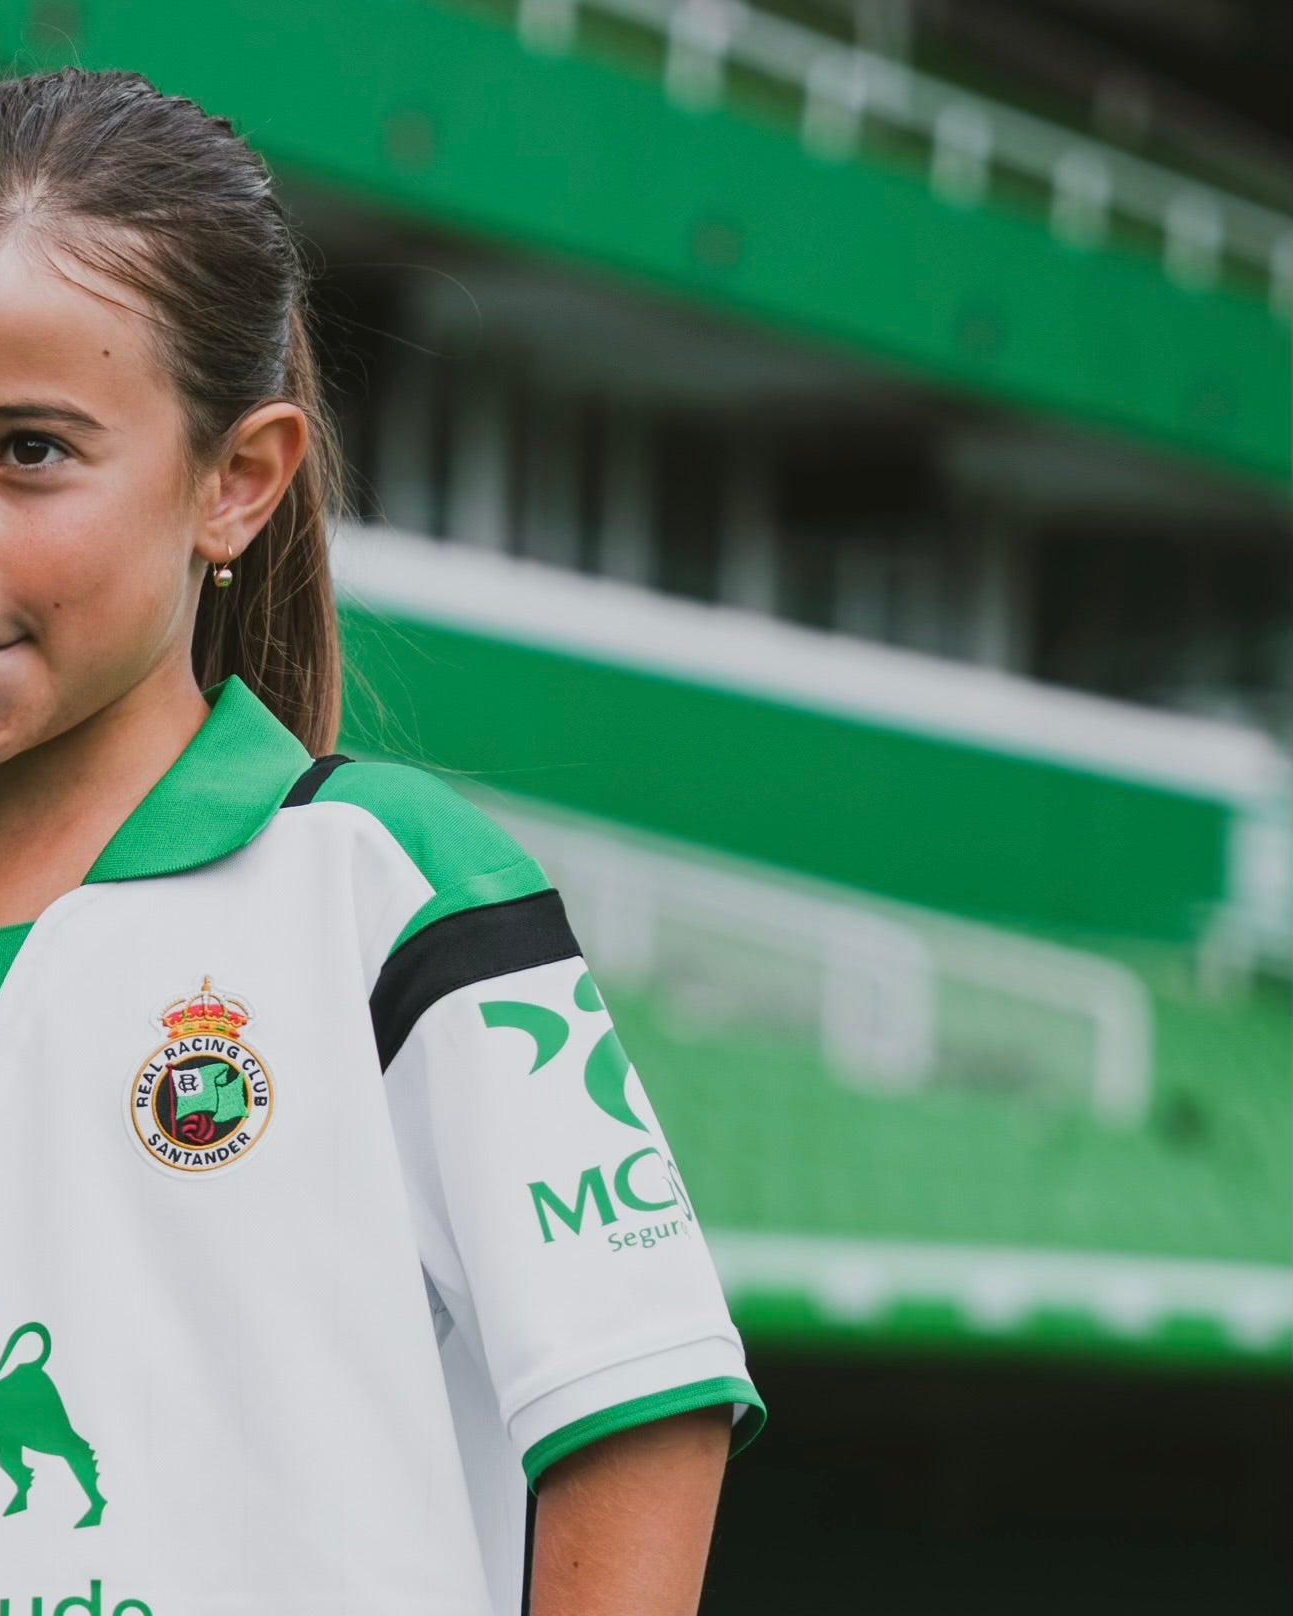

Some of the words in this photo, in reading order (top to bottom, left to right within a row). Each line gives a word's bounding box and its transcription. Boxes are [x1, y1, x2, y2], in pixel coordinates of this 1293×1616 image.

[136, 1063, 164, 1108] REAL
[163, 1038, 241, 1061] RACING
[242, 1058, 269, 1108] CLUB
[147, 1131, 252, 1166] SANTANDER
[607, 1219, 692, 1252] Segur
